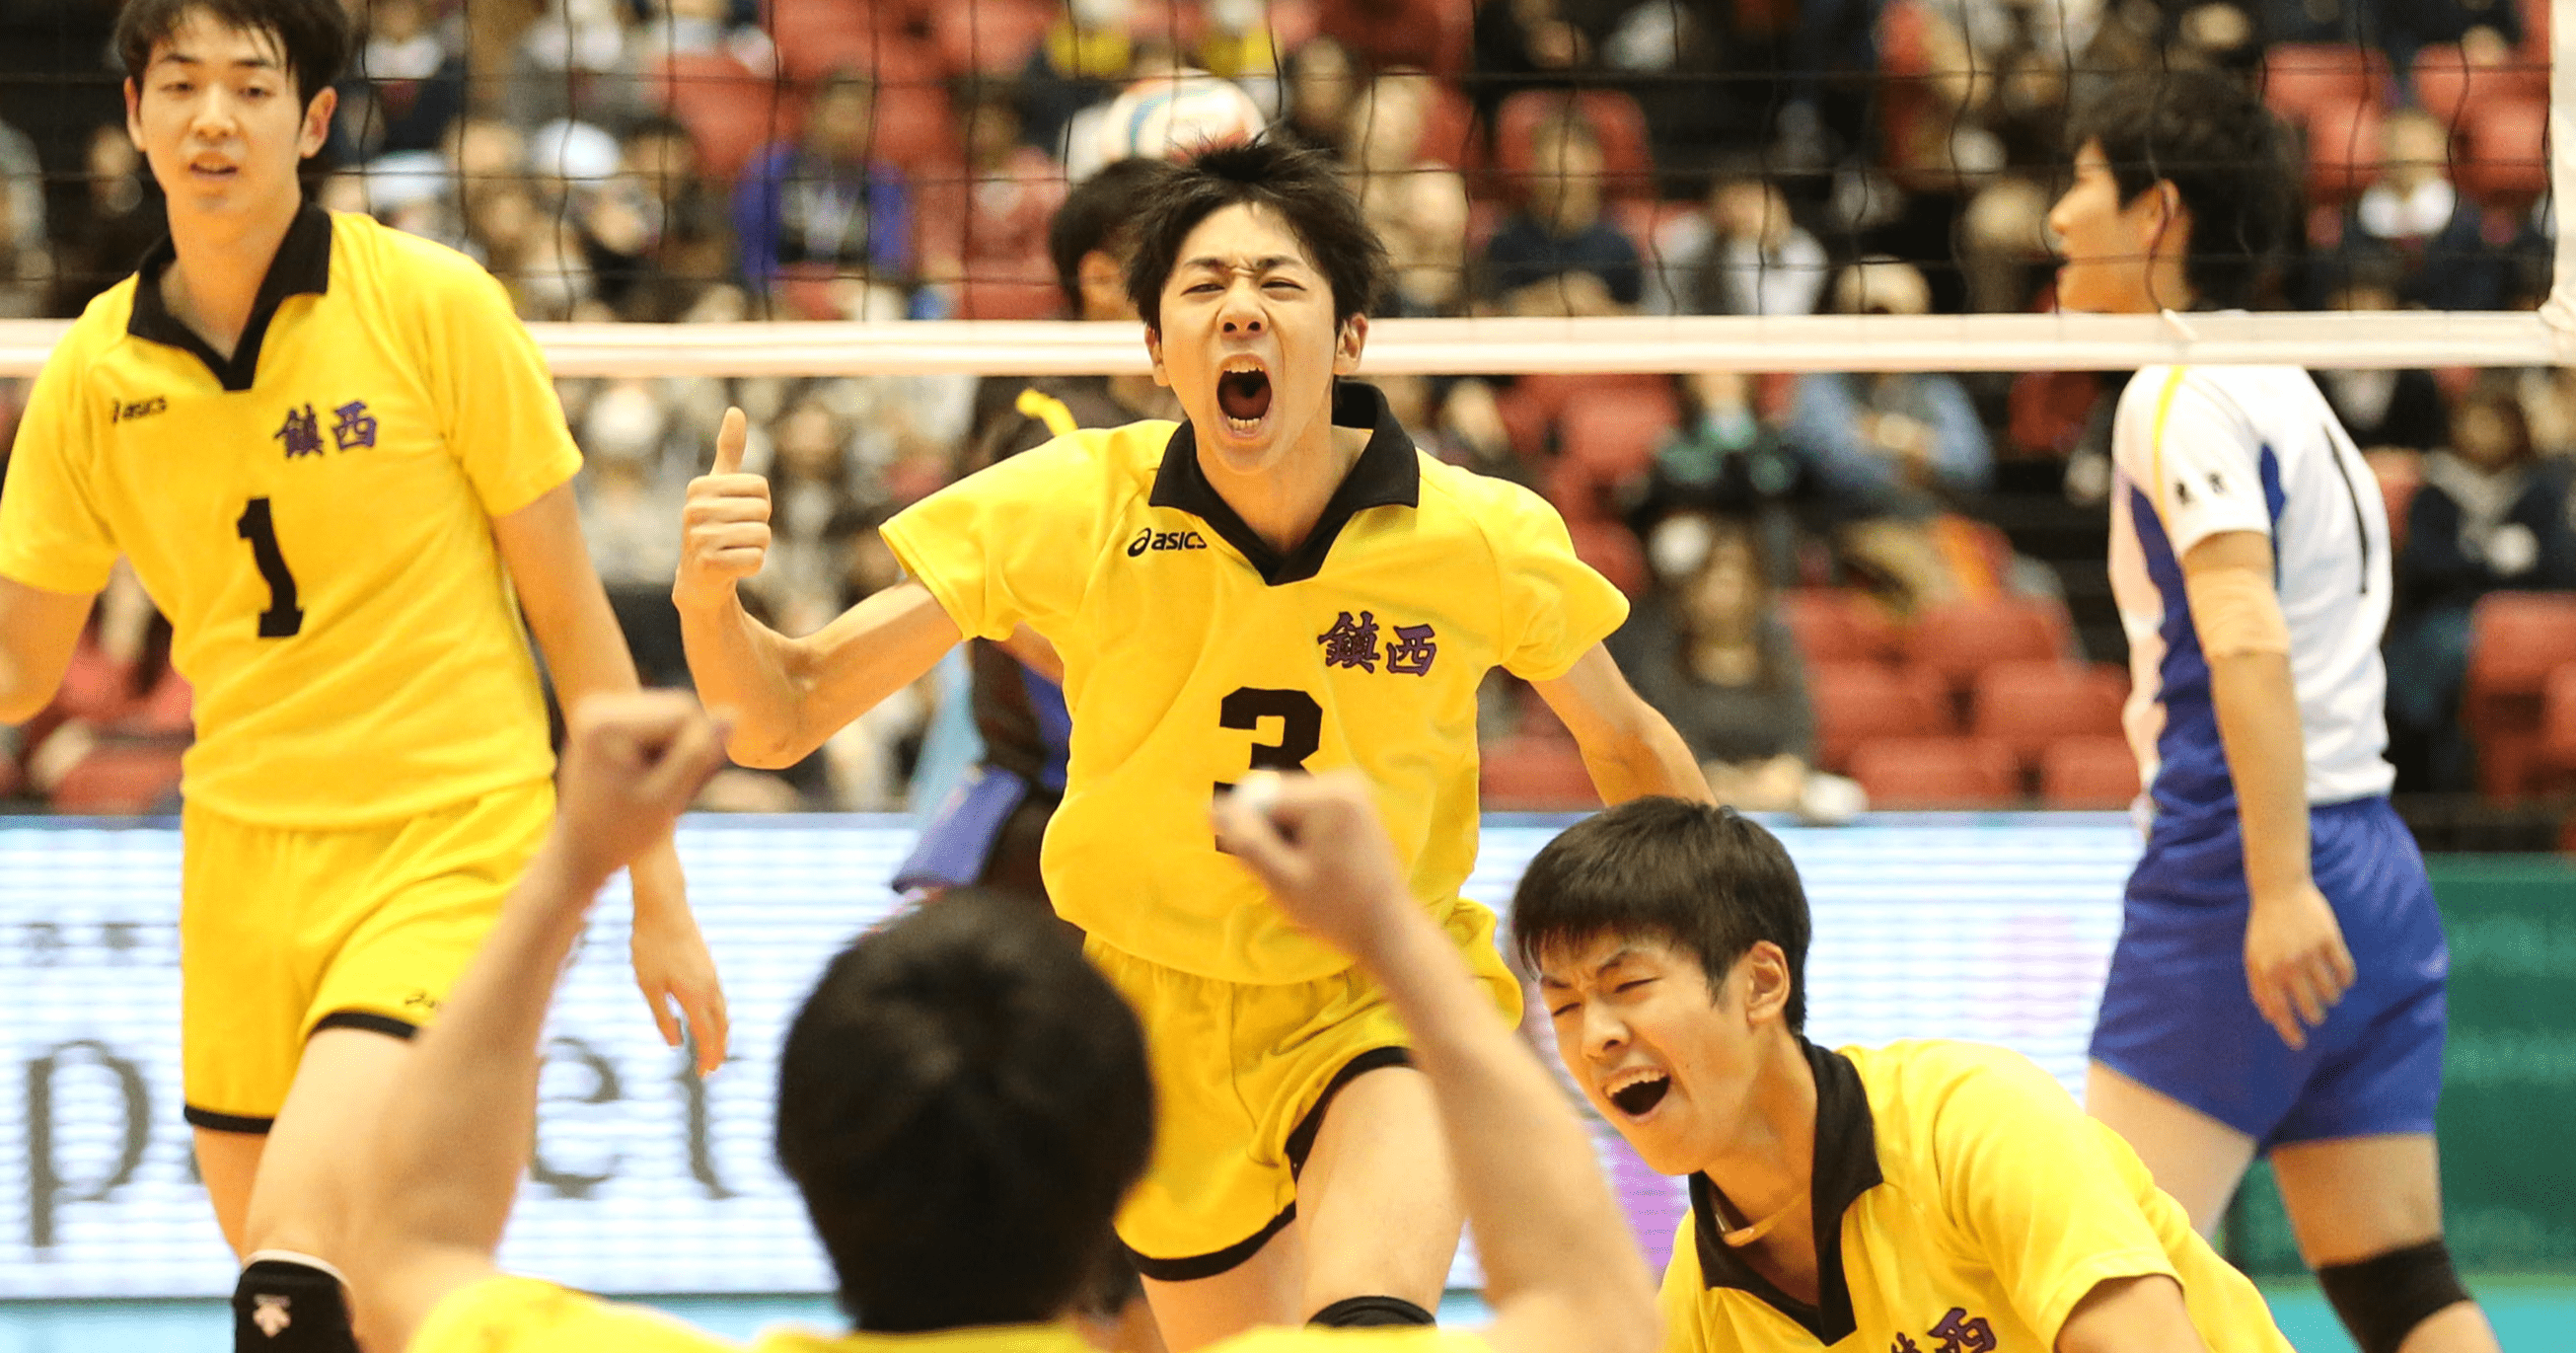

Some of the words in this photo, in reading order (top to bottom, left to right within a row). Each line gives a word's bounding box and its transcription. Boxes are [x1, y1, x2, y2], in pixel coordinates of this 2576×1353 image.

[273, 400, 377, 459] 鎮西
[237, 497, 304, 638] 1
[1317, 610, 1437, 677] 鎮西
[1214, 686, 1323, 855] 3
